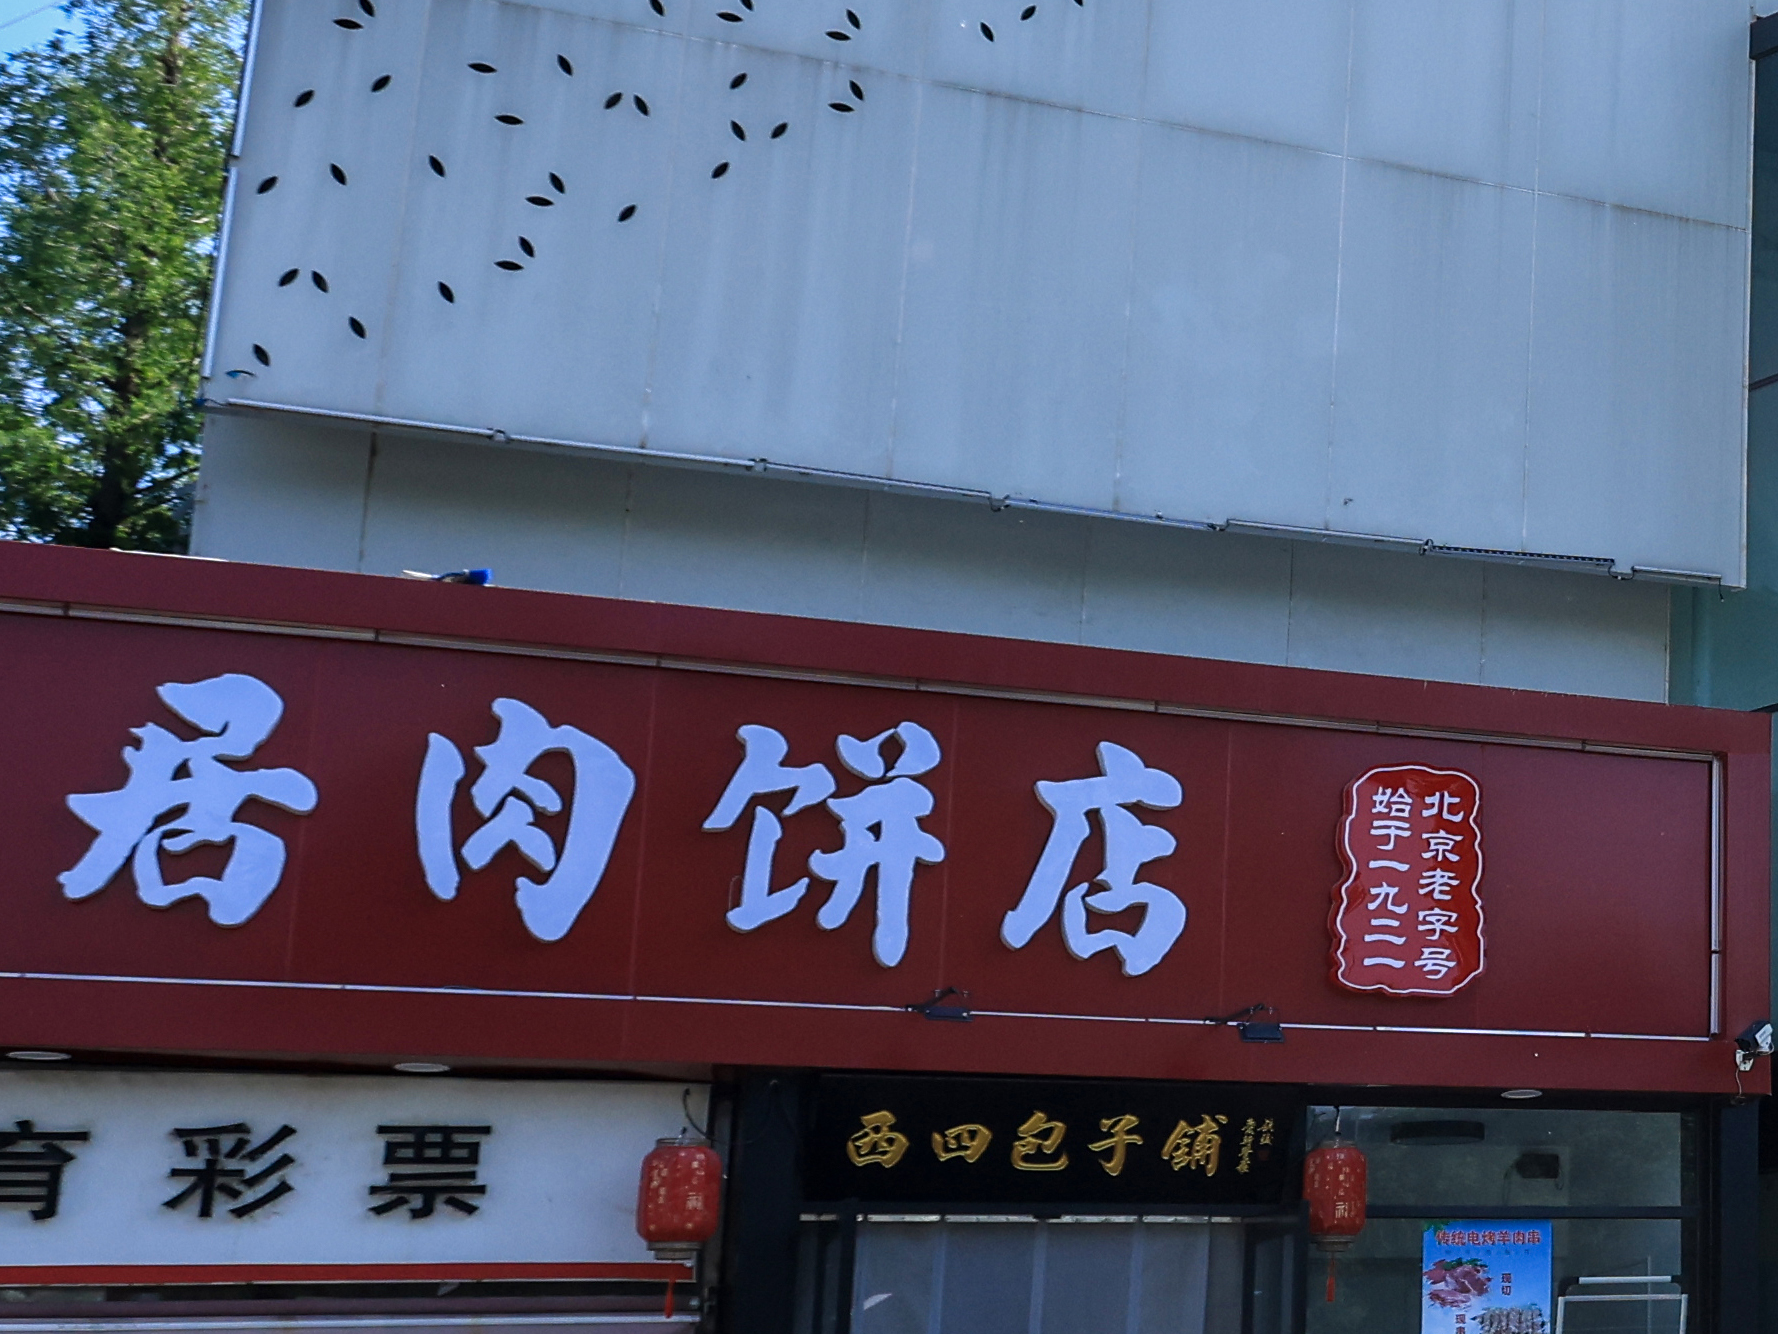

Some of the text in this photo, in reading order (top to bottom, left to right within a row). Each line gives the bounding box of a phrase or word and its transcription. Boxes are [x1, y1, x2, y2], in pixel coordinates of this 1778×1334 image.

[57, 672, 1188, 977] 居肉饼店
[1362, 785, 1414, 969] 始于一九二一
[1413, 790, 1465, 980] 北京老字号
[0, 1119, 492, 1221] 育彩票
